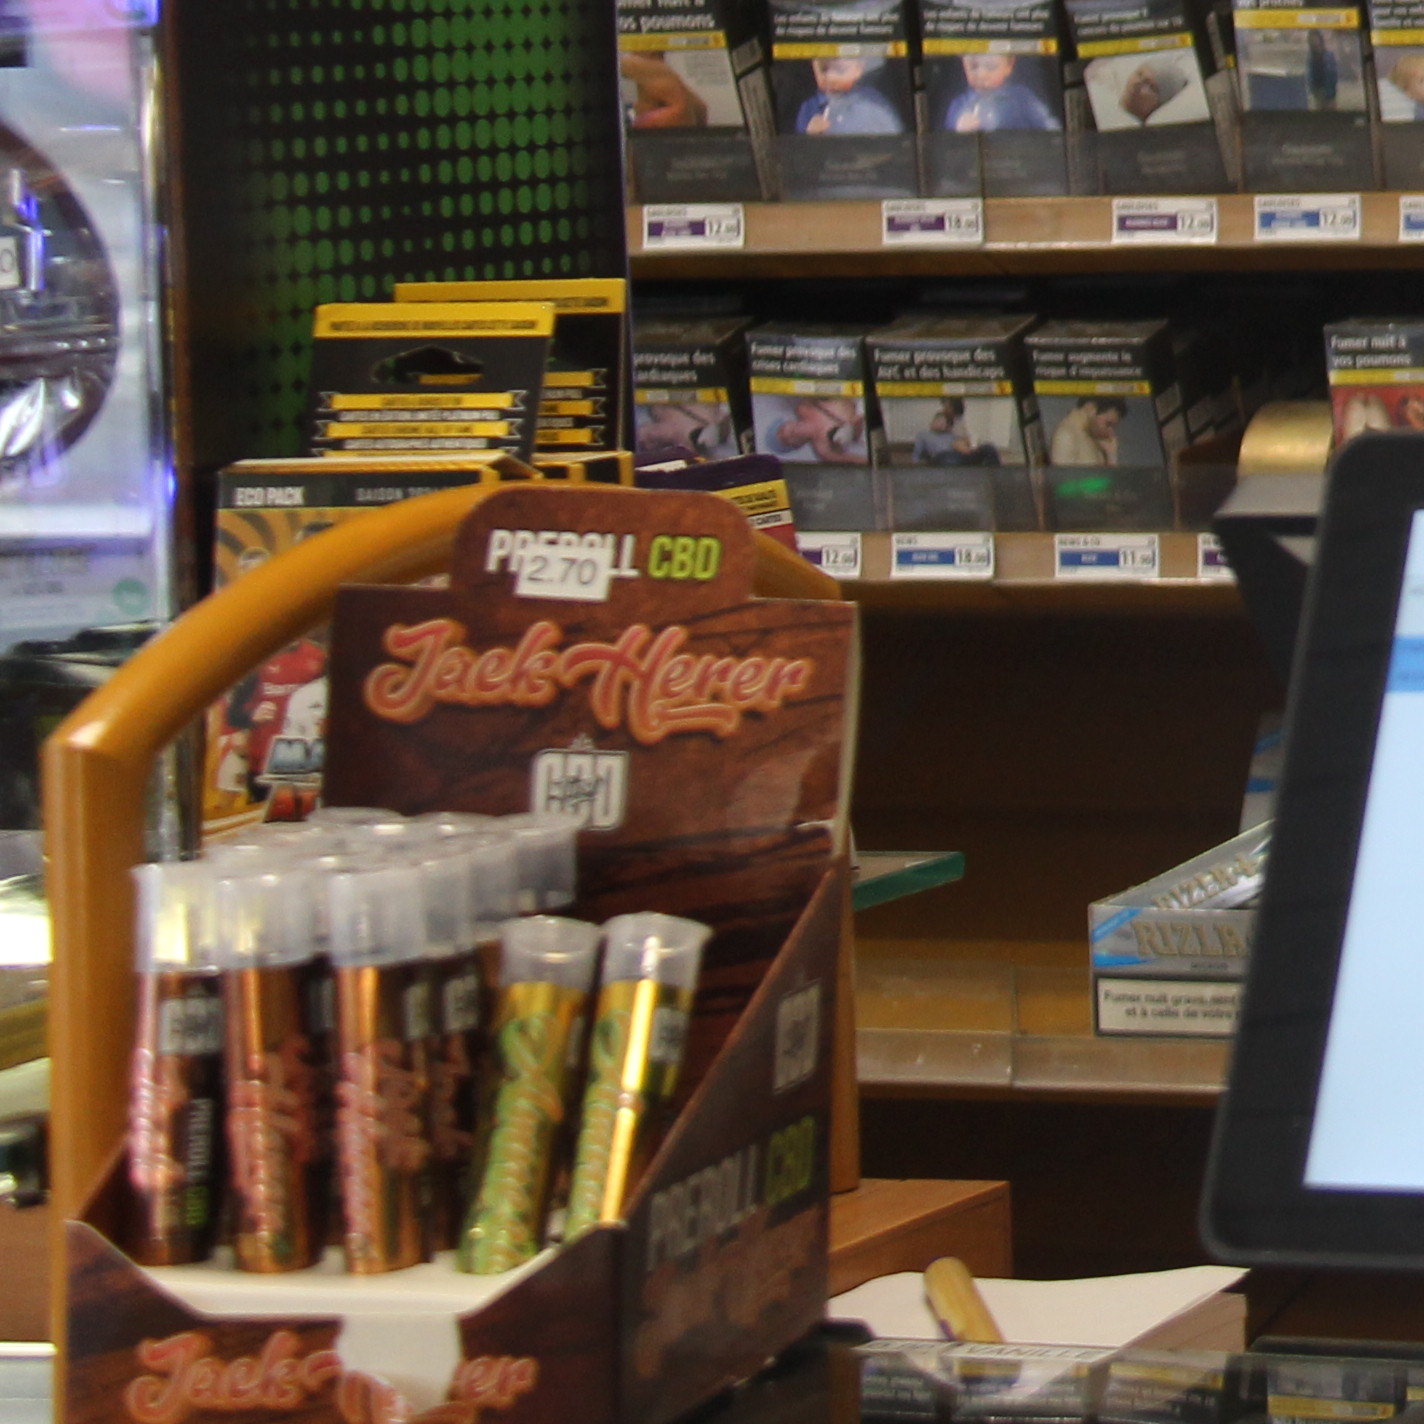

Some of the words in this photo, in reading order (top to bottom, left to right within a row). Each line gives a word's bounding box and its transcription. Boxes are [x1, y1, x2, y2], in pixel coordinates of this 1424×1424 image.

[266, 486, 305, 506] PACK
[527, 556, 598, 586] 2.70
[649, 535, 721, 580] CBD
[364, 617, 563, 724] Jack
[559, 624, 814, 746] Herer
